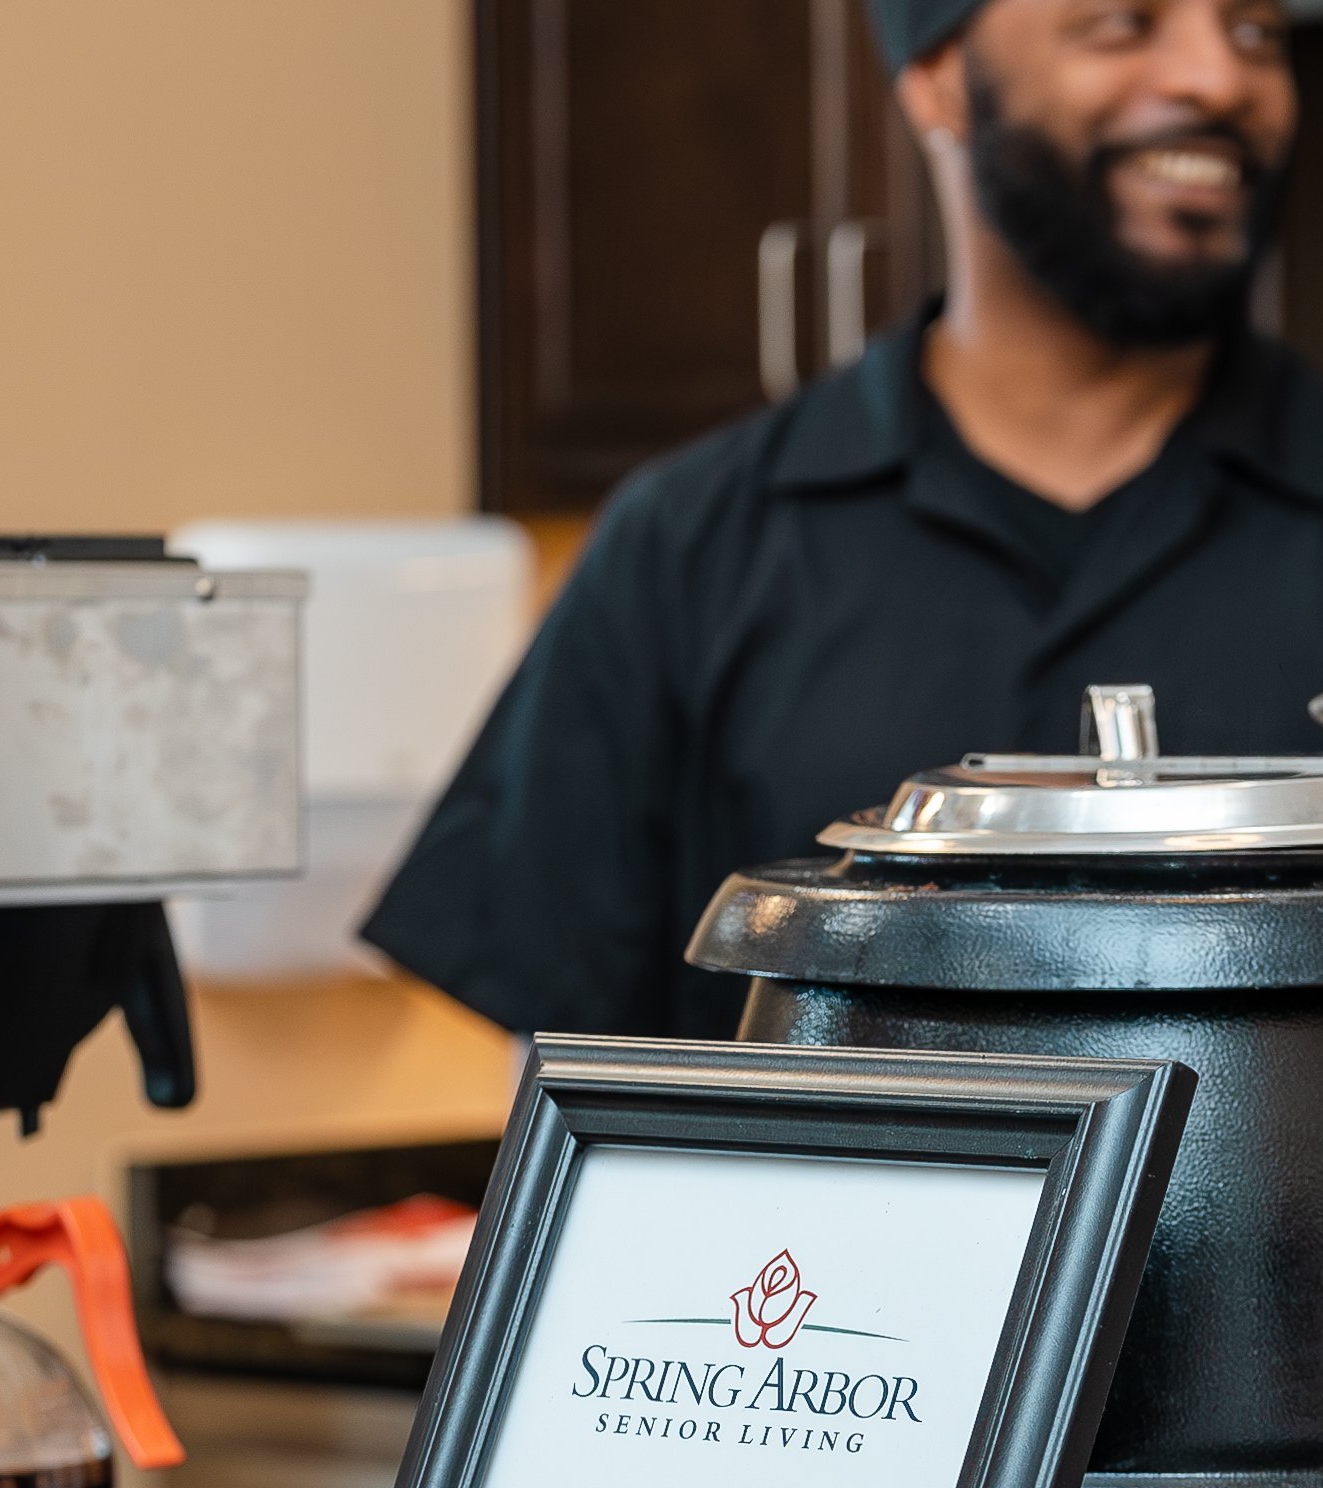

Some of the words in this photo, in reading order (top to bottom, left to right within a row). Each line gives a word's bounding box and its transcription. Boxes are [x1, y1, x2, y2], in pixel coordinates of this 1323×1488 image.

[571, 1344, 745, 1408] SPRING
[745, 1356, 923, 1423] ARBOR
[595, 1413, 722, 1442] SENIOR
[738, 1424, 865, 1453] LIVING
